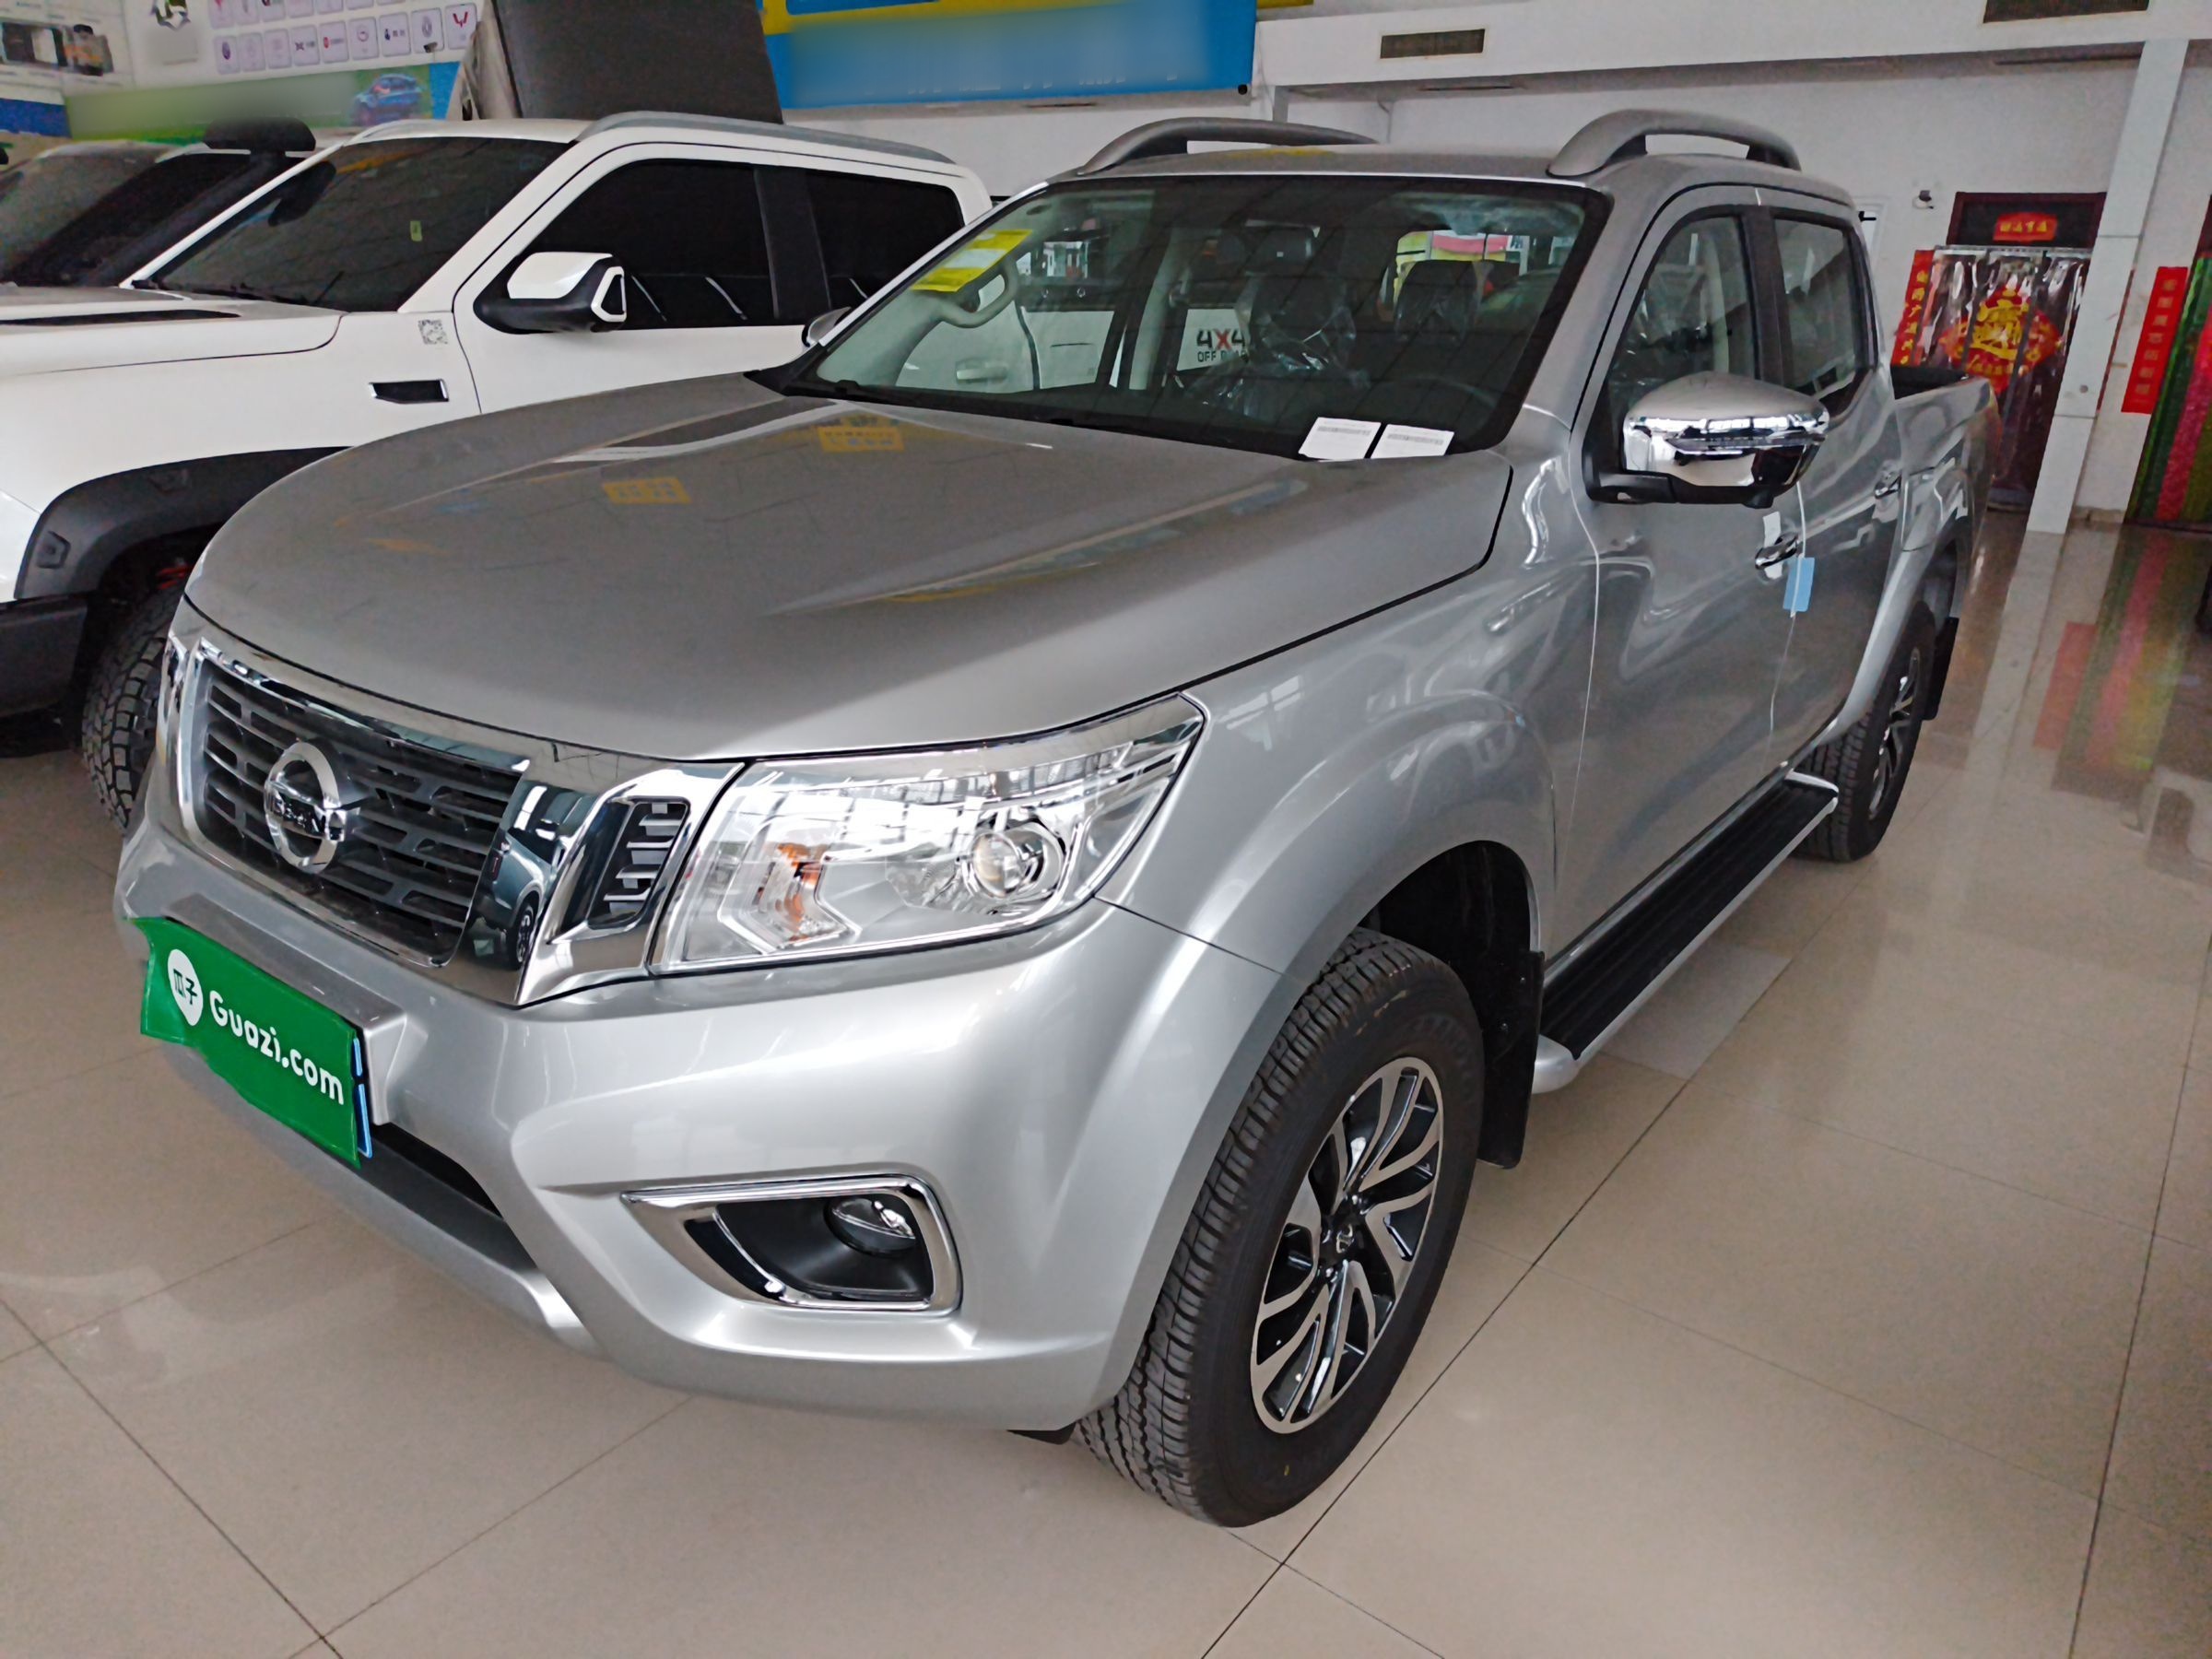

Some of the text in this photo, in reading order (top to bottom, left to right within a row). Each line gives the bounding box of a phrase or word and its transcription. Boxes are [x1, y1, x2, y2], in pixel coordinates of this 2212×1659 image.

[1196, 328, 1246, 350] 4X4
[1197, 350, 1217, 362] OFF
[172, 968, 198, 1006] 瓜子
[209, 990, 345, 1105] Guazi.com
